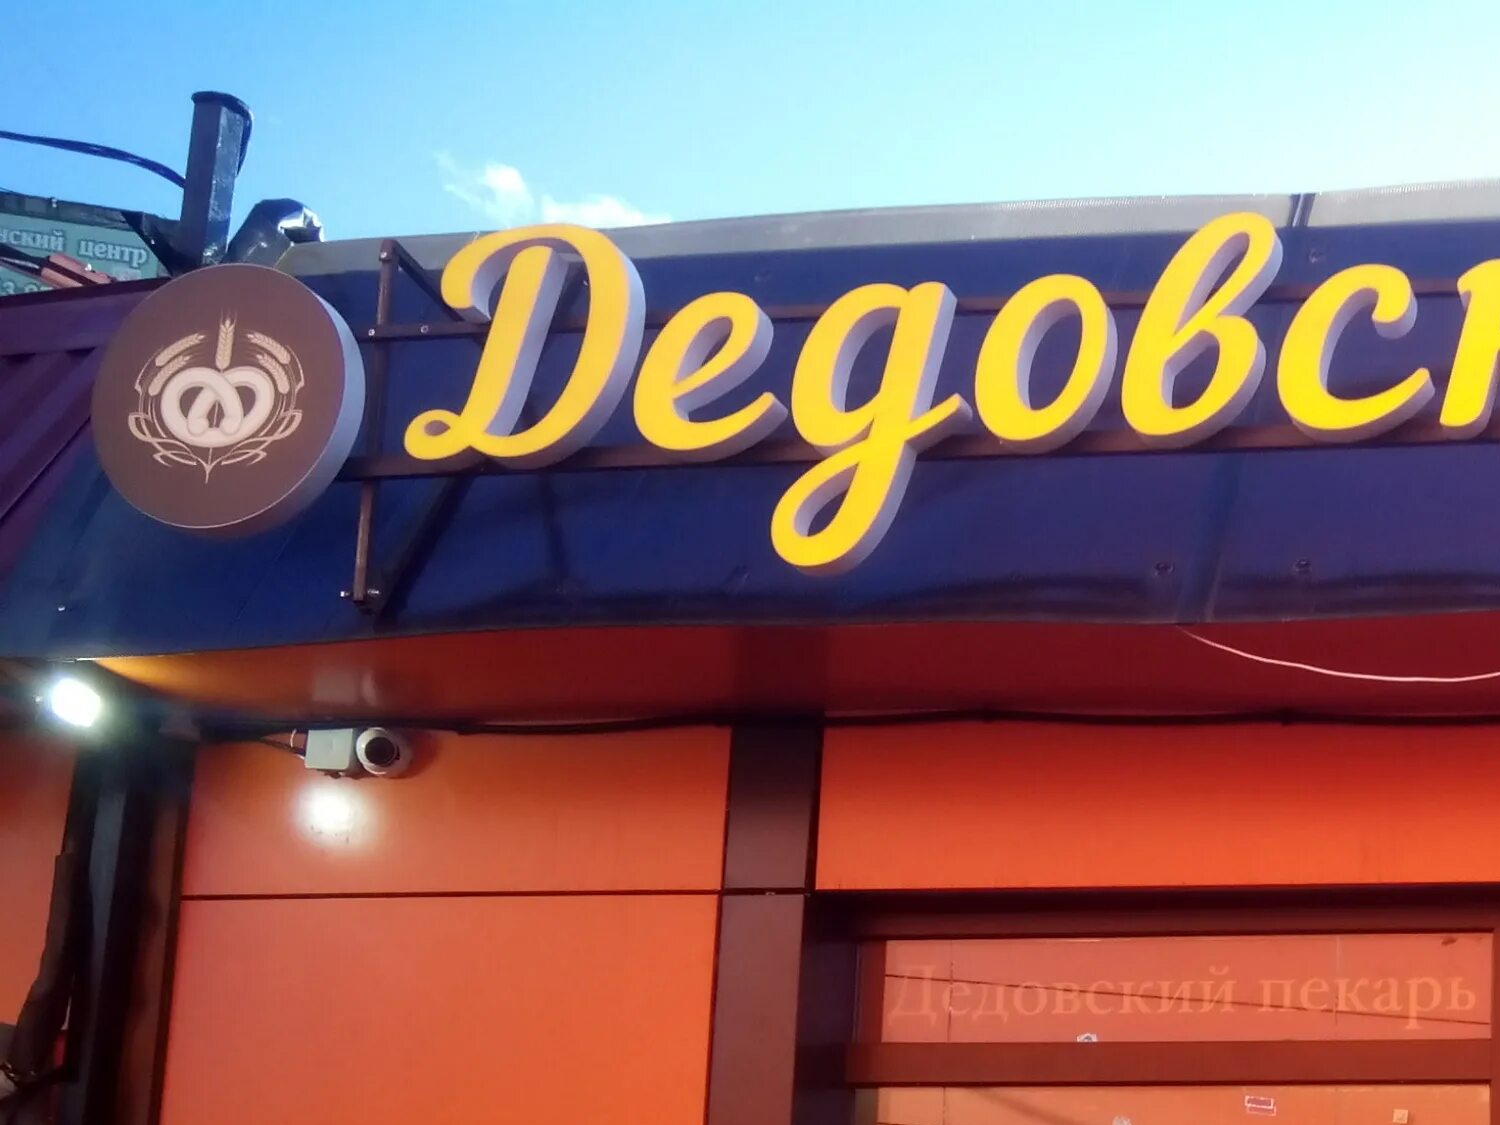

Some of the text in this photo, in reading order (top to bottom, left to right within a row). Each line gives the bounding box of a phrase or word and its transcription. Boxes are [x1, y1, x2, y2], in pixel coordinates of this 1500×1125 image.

[78, 239, 149, 269] центр
[885, 964, 1477, 1031] Дедовский пекарь
